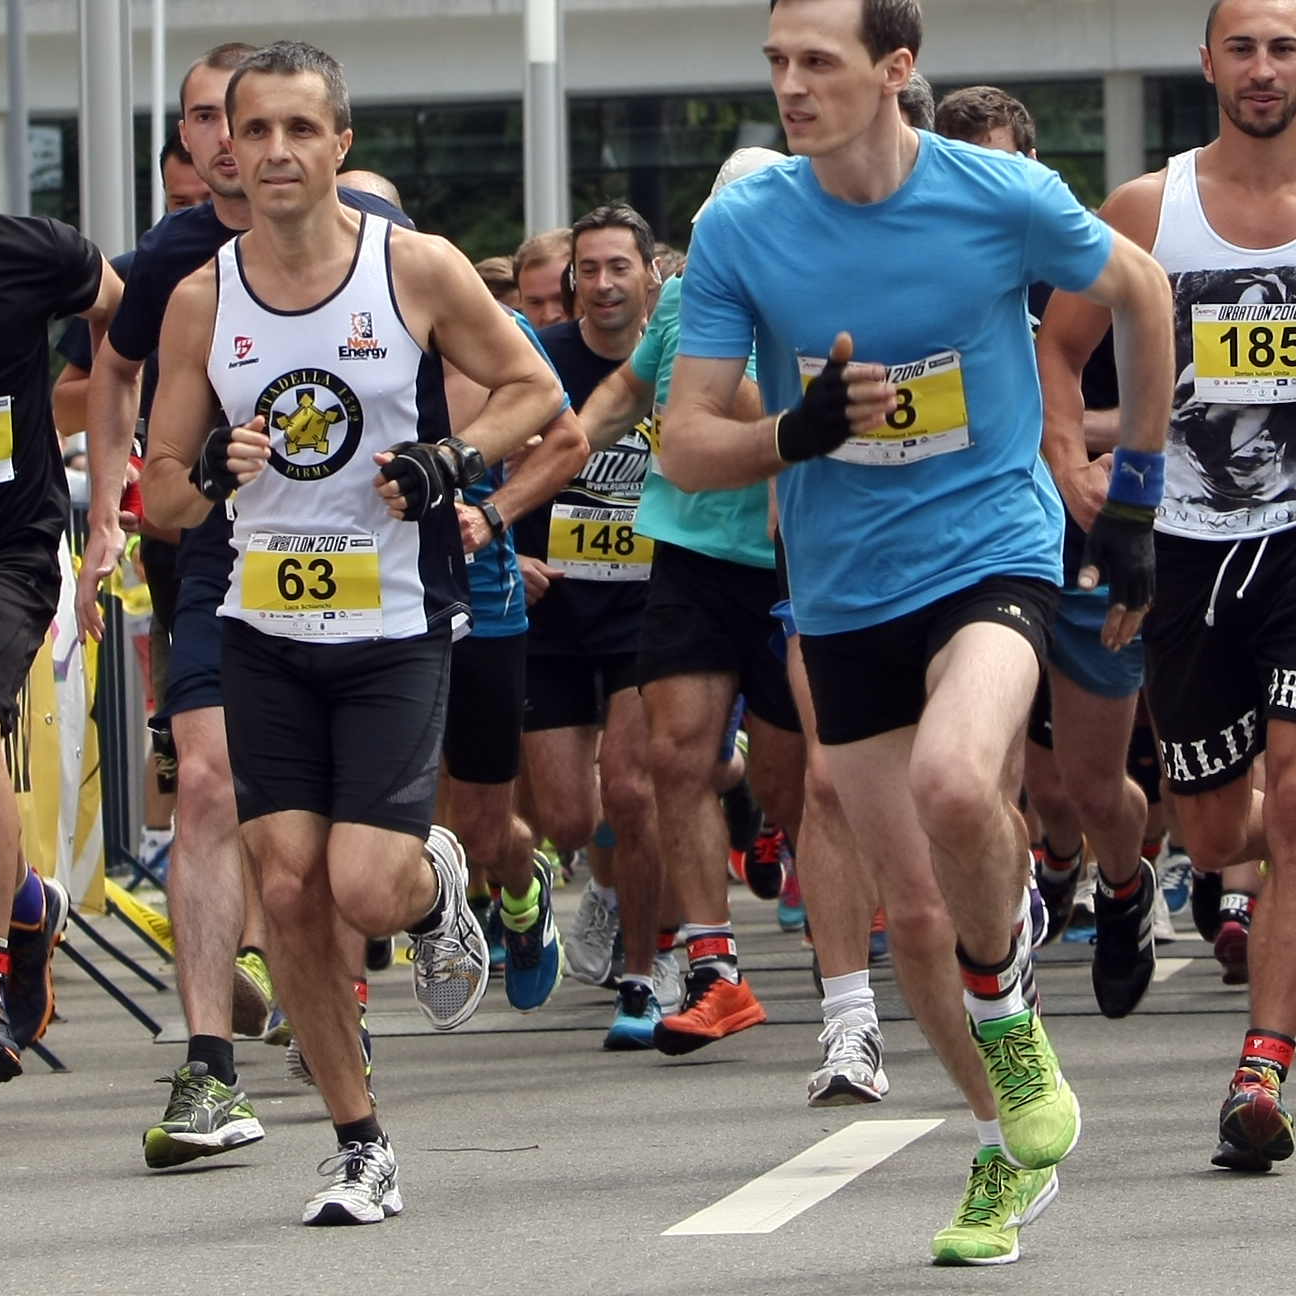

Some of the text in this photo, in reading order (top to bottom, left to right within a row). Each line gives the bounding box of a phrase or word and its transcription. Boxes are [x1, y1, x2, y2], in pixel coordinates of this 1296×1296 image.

[338, 346, 389, 360] Energy
[347, 337, 379, 350] New
[891, 359, 927, 384] 2016
[285, 464, 331, 479] PARMA
[577, 450, 651, 483] ATLON
[314, 535, 348, 553] 2016
[570, 523, 635, 557] 148
[277, 557, 338, 601] 63
